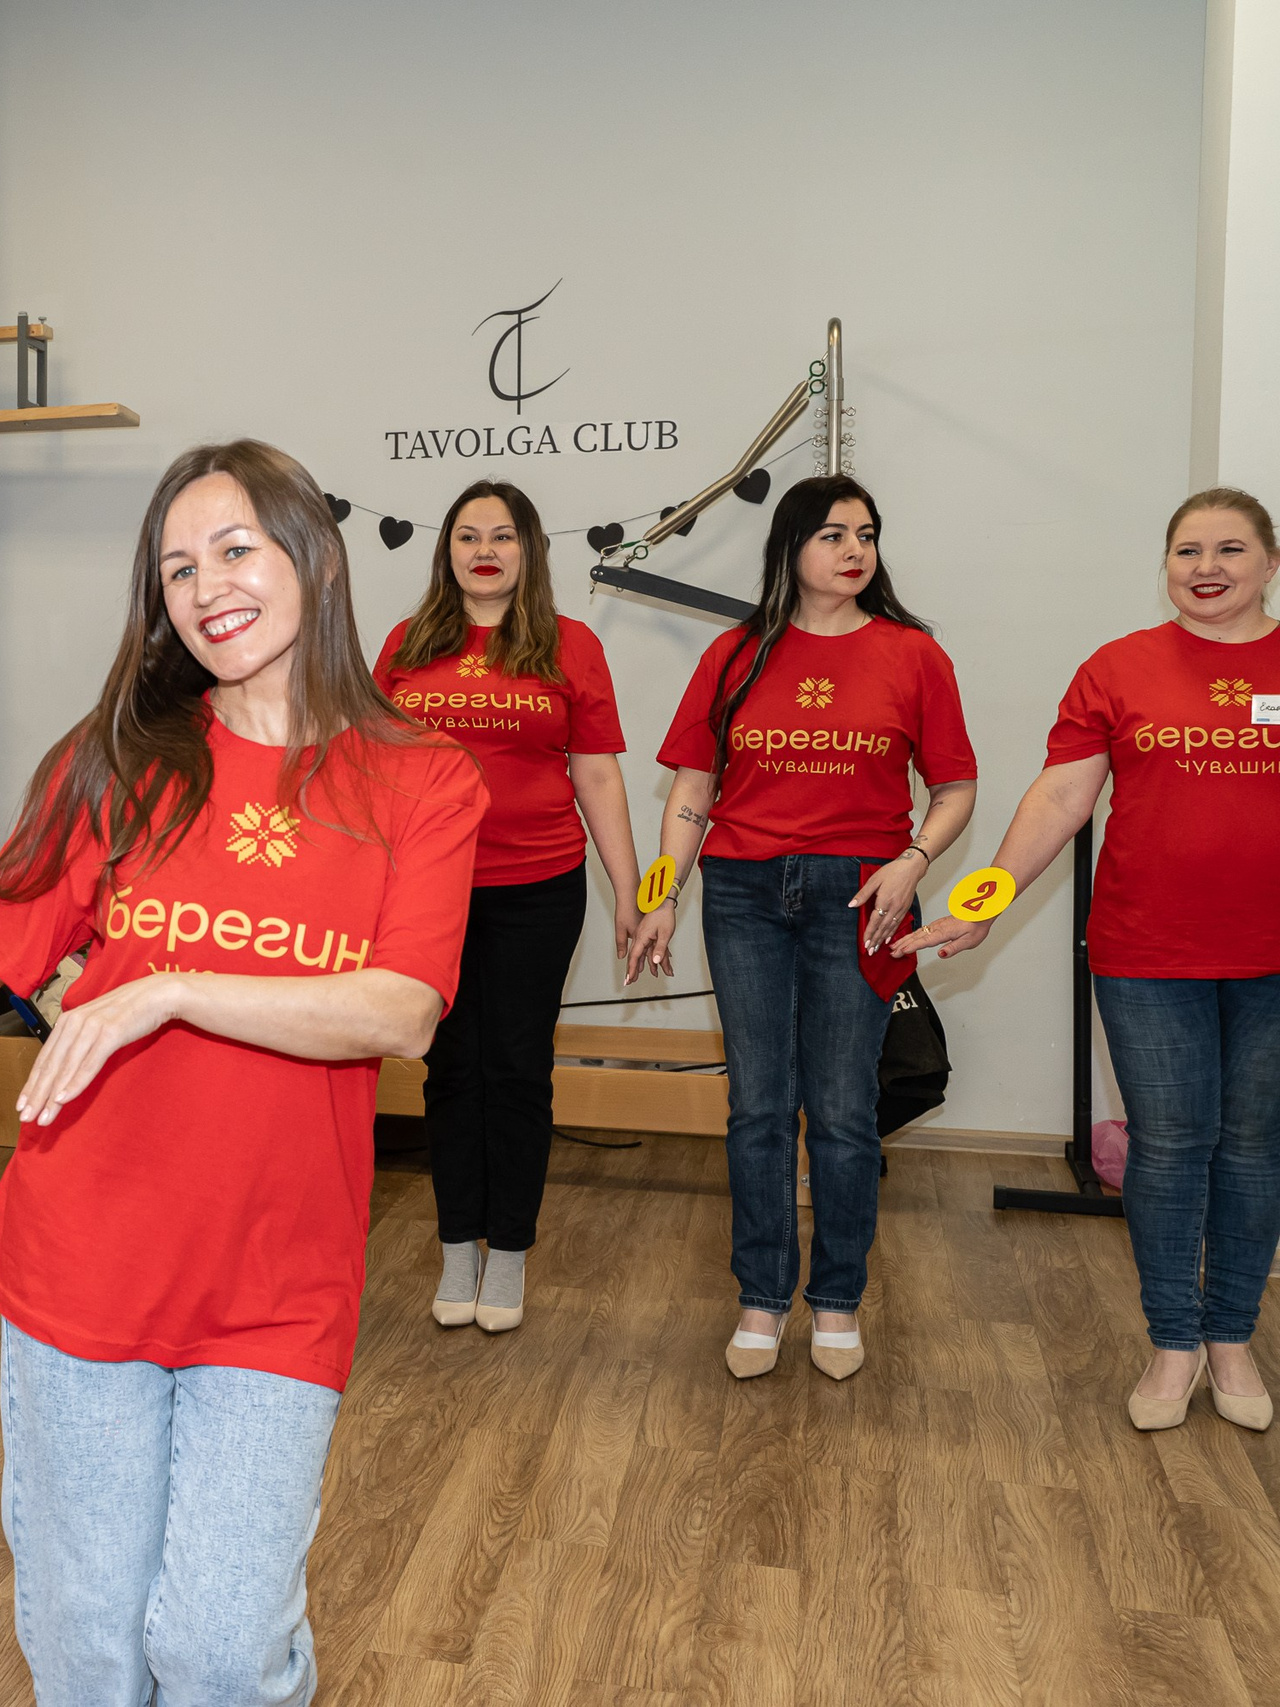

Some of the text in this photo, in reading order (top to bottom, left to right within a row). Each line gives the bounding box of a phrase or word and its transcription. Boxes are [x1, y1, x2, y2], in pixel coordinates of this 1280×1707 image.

[385, 420, 679, 460] TAVOLGA CLUB
[731, 724, 891, 757] берегиня
[757, 760, 855, 776] чувашии
[1175, 760, 1280, 776] чуваши
[648, 865, 666, 904] 11
[961, 881, 997, 912] 2
[106, 886, 375, 972] берегин
